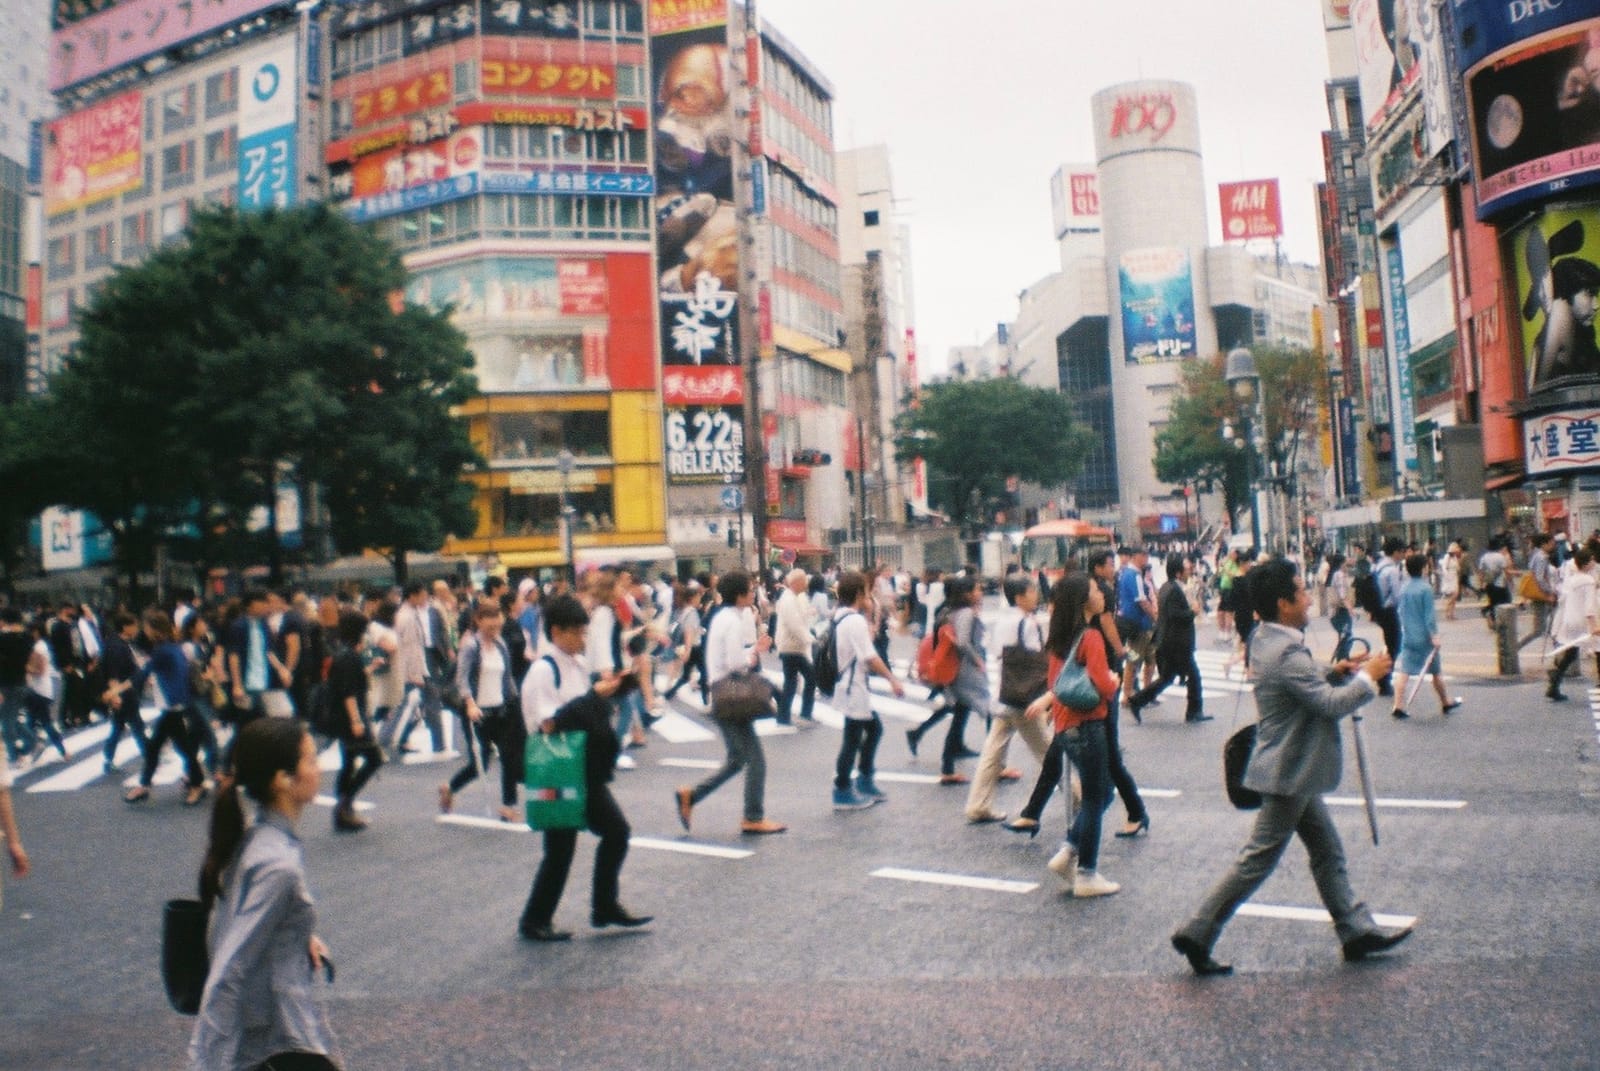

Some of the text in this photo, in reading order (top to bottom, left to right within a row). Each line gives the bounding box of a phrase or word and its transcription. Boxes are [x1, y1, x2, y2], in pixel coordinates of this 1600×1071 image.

[482, 61, 611, 91] コンタクト
[574, 108, 634, 132] ガスト
[1109, 93, 1177, 142] 109
[667, 410, 731, 451] 6.22
[668, 450, 744, 474] RELEASE
